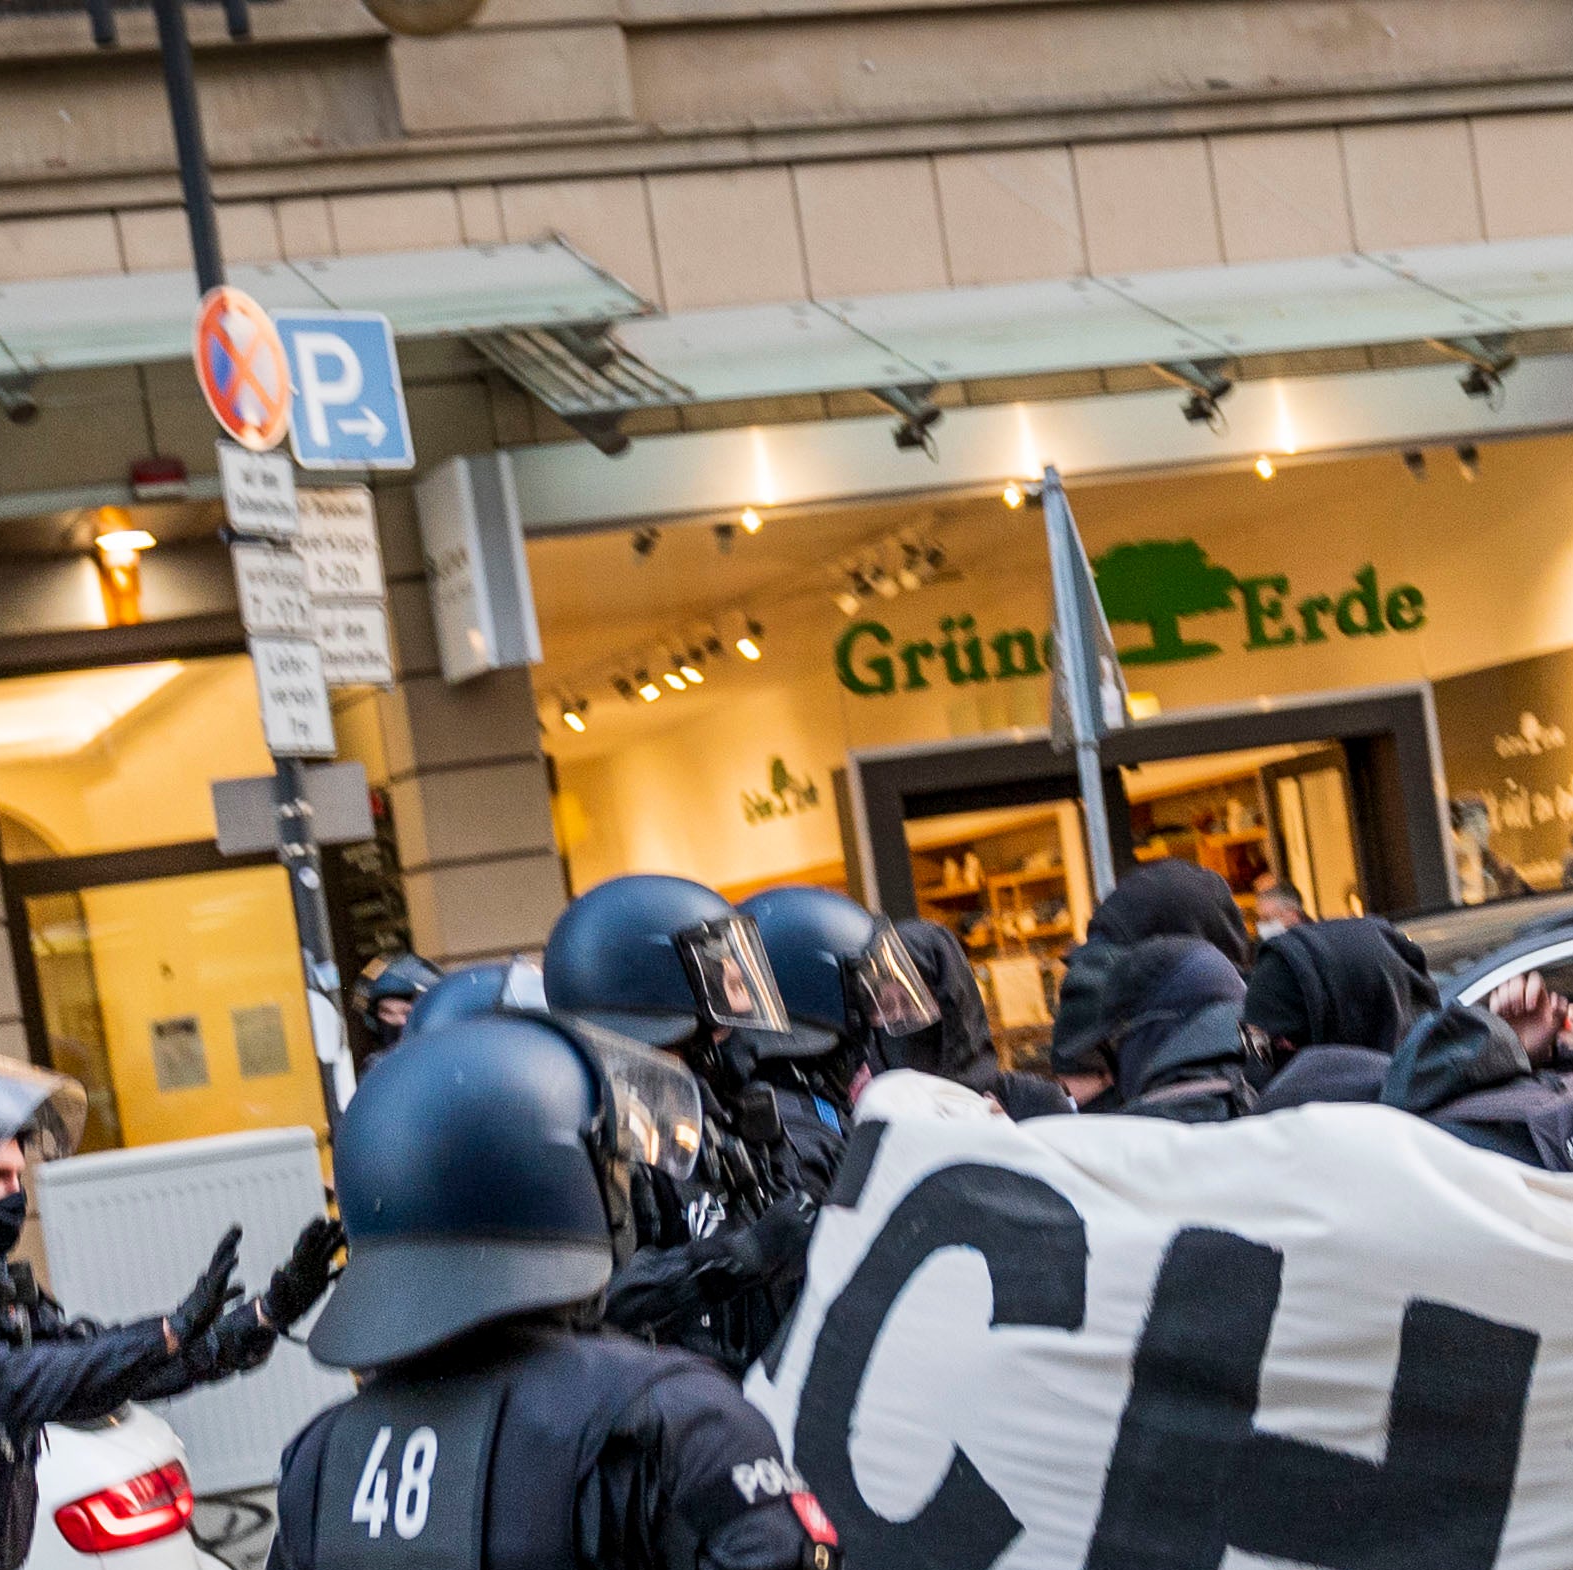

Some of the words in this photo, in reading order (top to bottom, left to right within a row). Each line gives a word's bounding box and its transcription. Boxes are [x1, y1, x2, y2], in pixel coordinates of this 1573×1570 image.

[293, 331, 363, 446] P
[1233, 562, 1426, 652] Erde
[352, 1426, 439, 1540] 48
